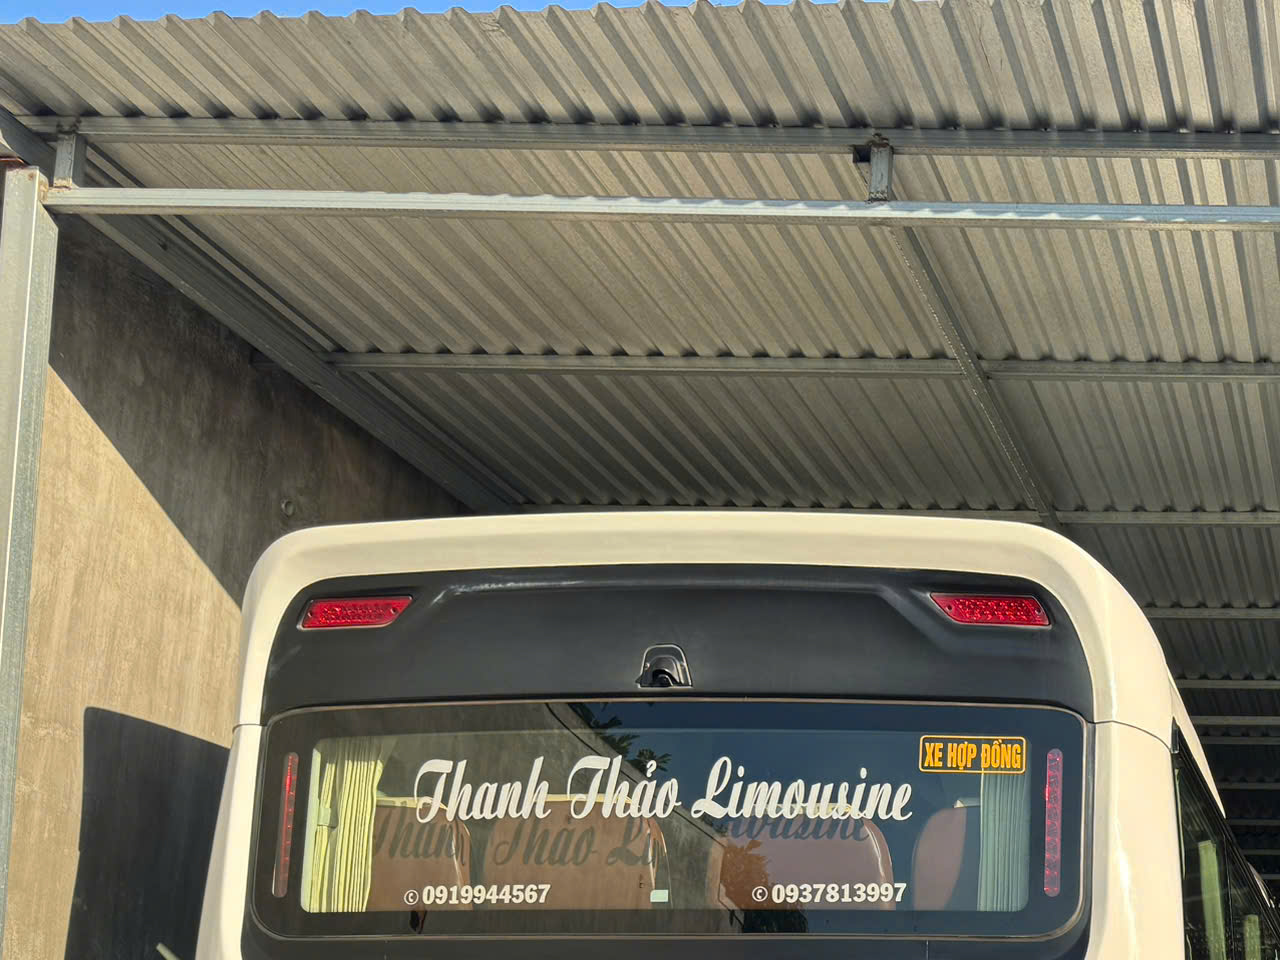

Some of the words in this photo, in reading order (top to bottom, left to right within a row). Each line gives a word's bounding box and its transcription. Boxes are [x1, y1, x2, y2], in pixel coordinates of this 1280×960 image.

[924, 742, 944, 767] XE
[947, 741, 977, 770] HỢP
[981, 739, 1021, 769] ĐỒNG
[414, 756, 551, 823] Thanh
[566, 755, 682, 819] Thảo
[691, 756, 913, 821] Limousine
[422, 884, 551, 905] 0919944567
[771, 882, 907, 904] 0937813997
